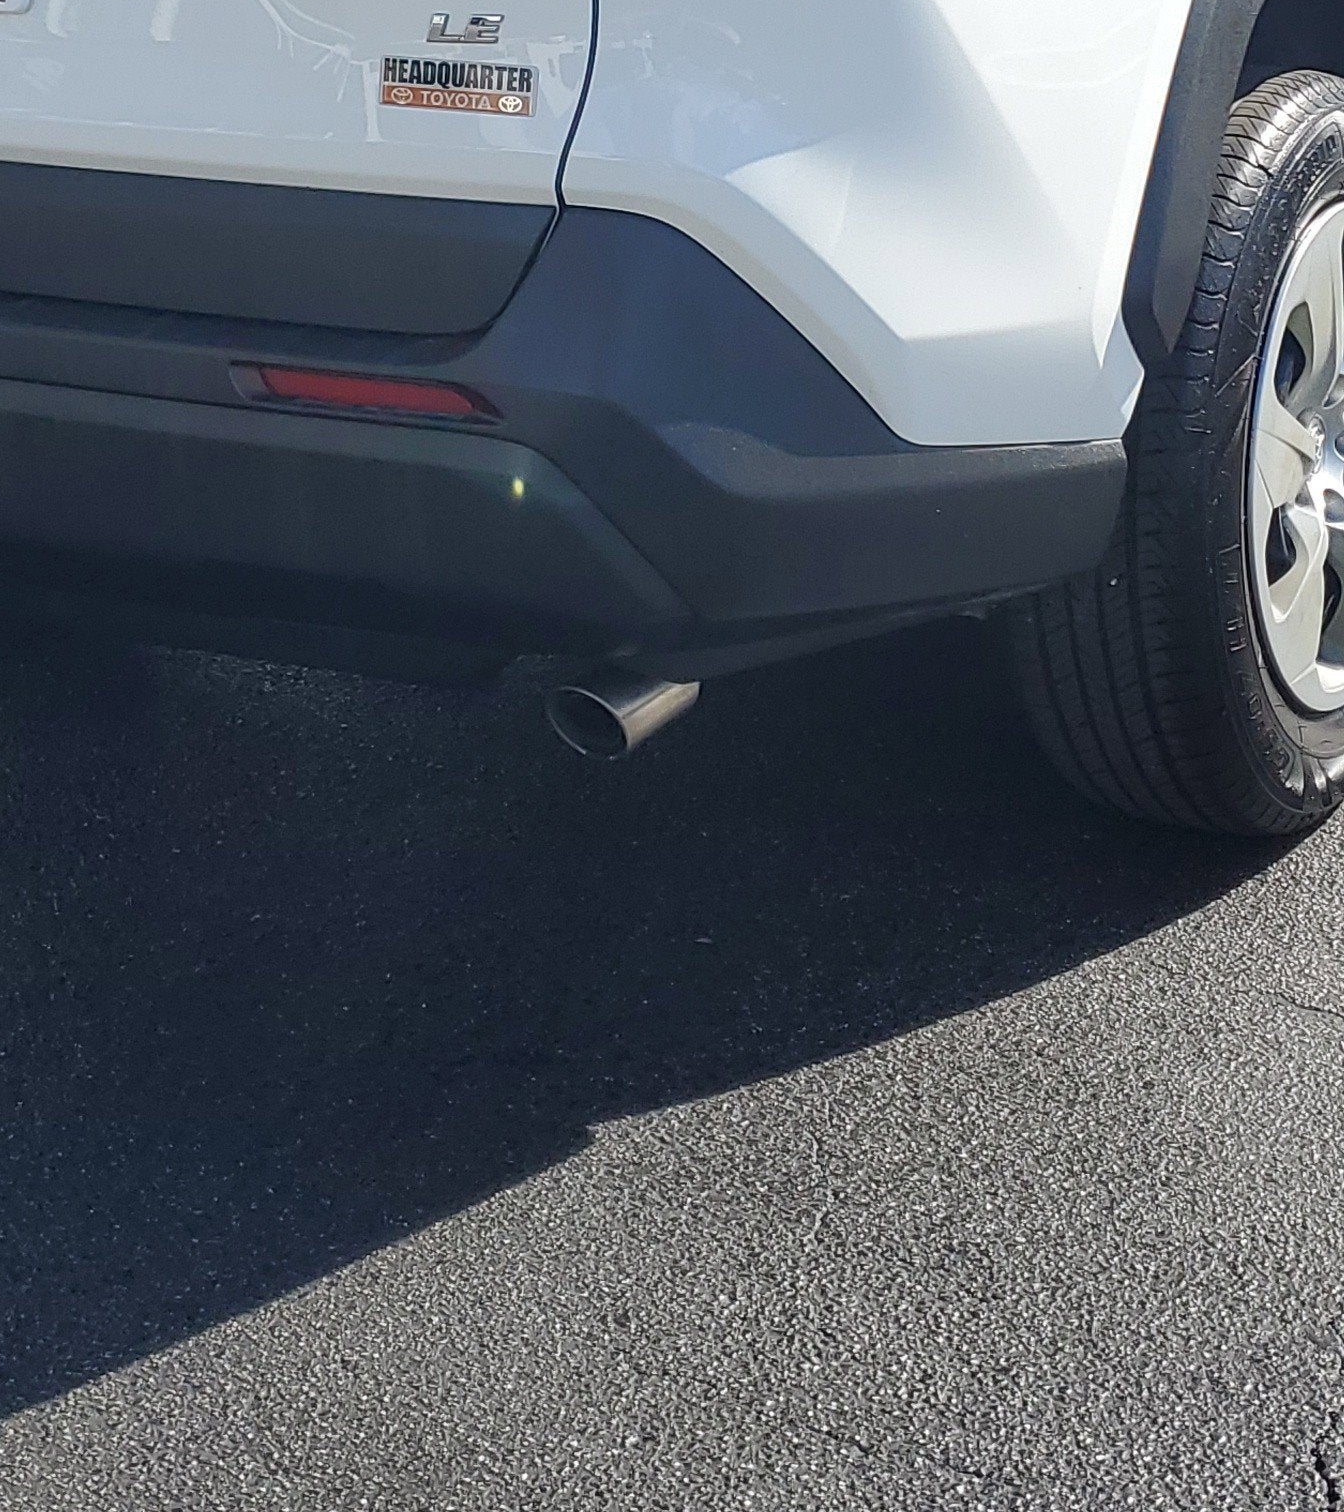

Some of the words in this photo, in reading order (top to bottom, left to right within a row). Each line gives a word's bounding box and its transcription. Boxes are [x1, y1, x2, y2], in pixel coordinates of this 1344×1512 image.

[426, 13, 505, 44] LE
[383, 57, 534, 93] HEADQUARTER
[420, 90, 492, 110] TOYOTA
